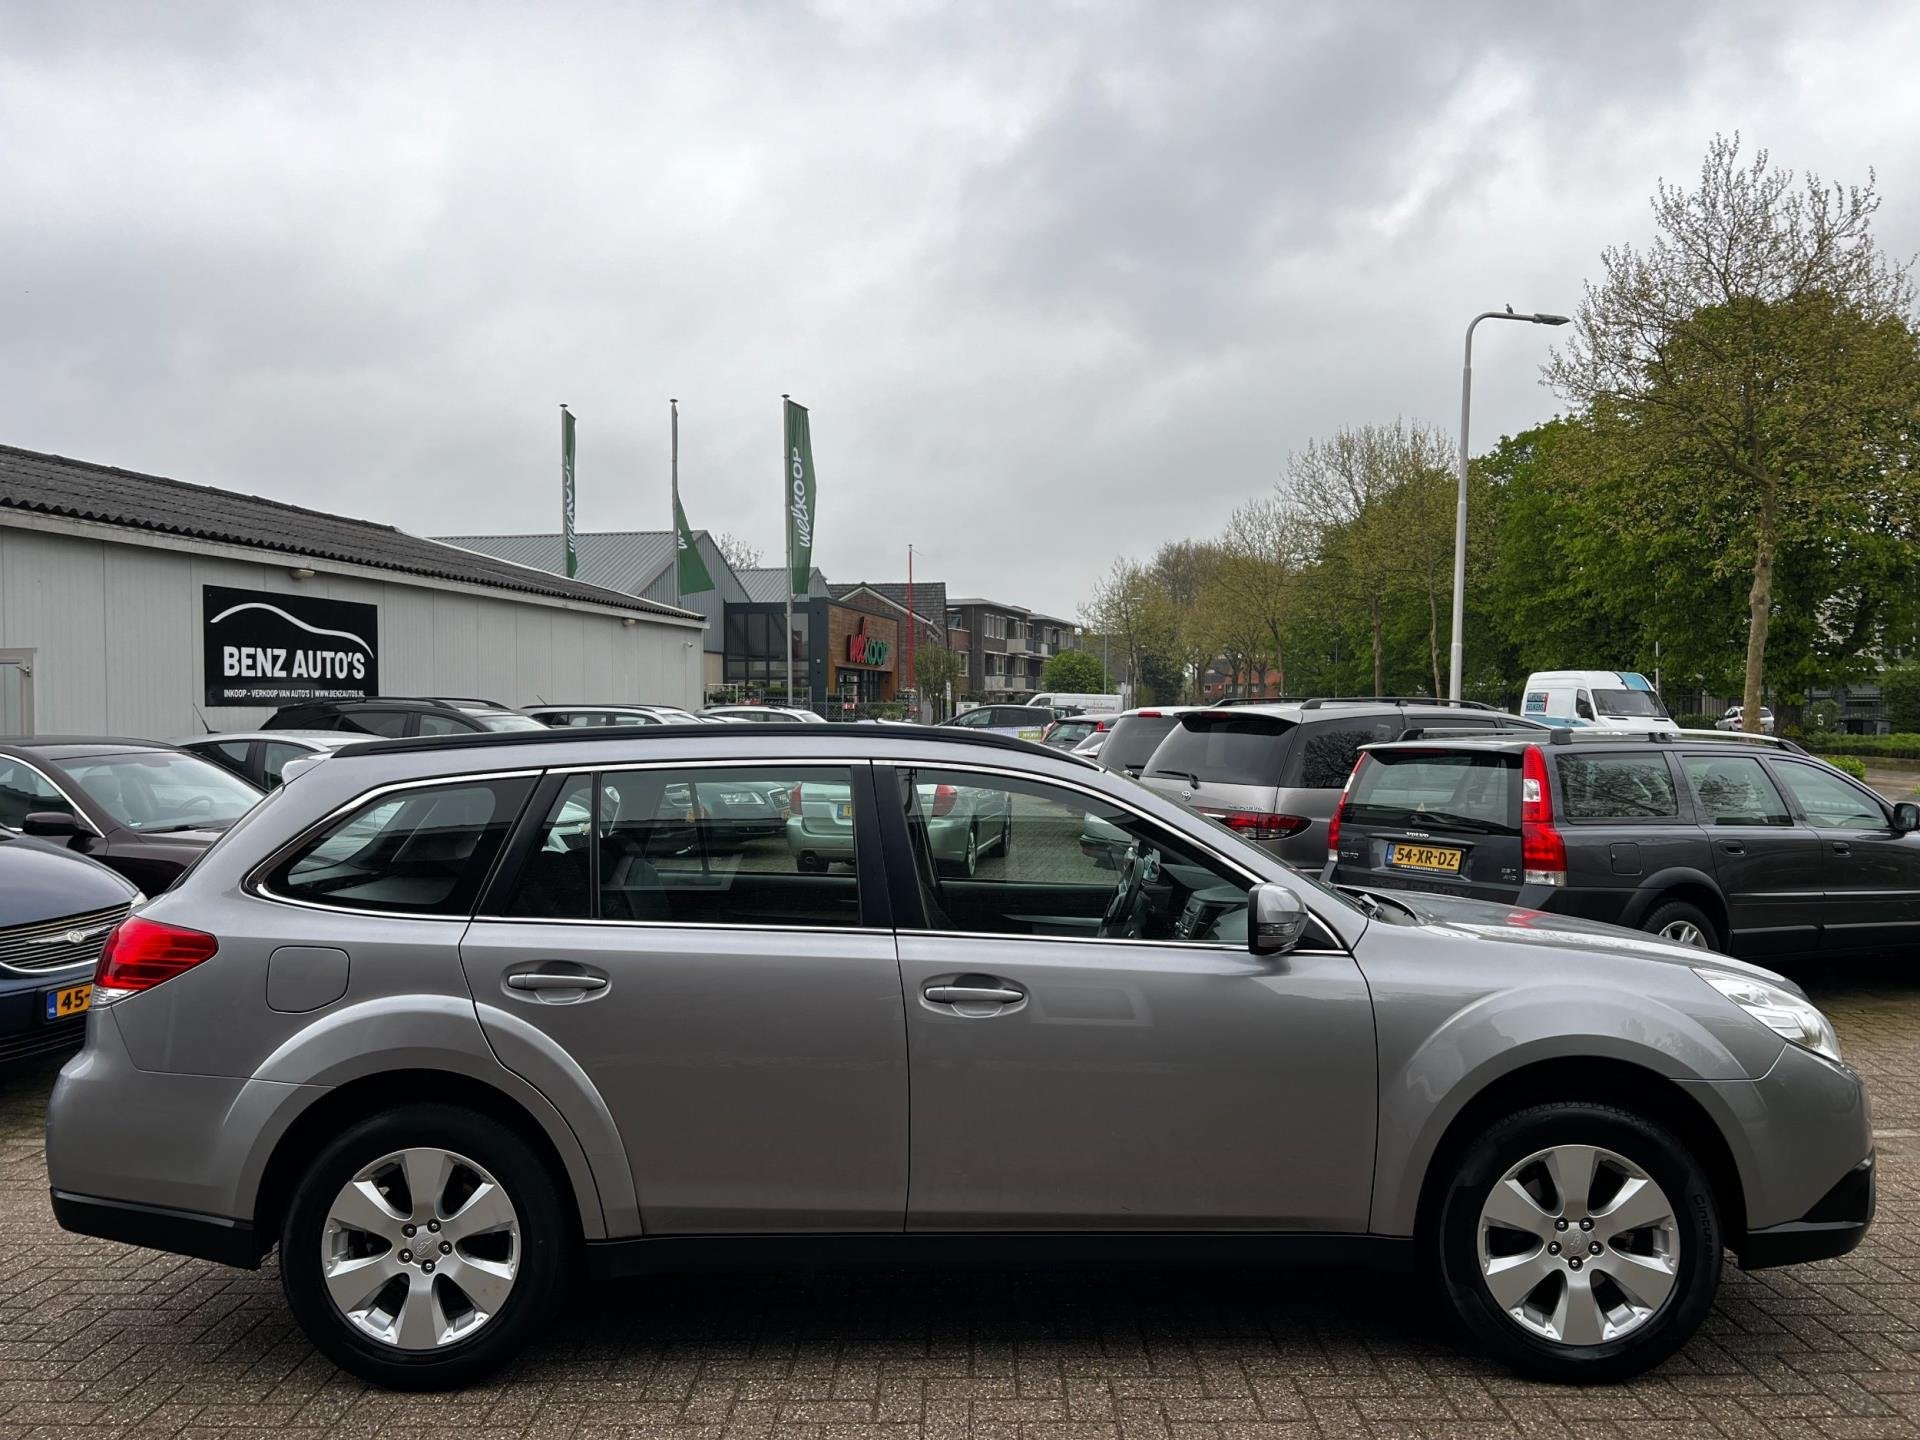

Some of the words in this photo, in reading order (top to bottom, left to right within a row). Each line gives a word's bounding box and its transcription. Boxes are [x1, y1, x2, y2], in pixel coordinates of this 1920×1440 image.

[223, 646, 287, 678] BENZ
[291, 649, 366, 680] AUTO'S
[224, 689, 247, 698] INKOOP
[251, 689, 278, 698] VERKOOP
[278, 689, 290, 698] VAN
[1396, 847, 1457, 867] 54-XR-DZ
